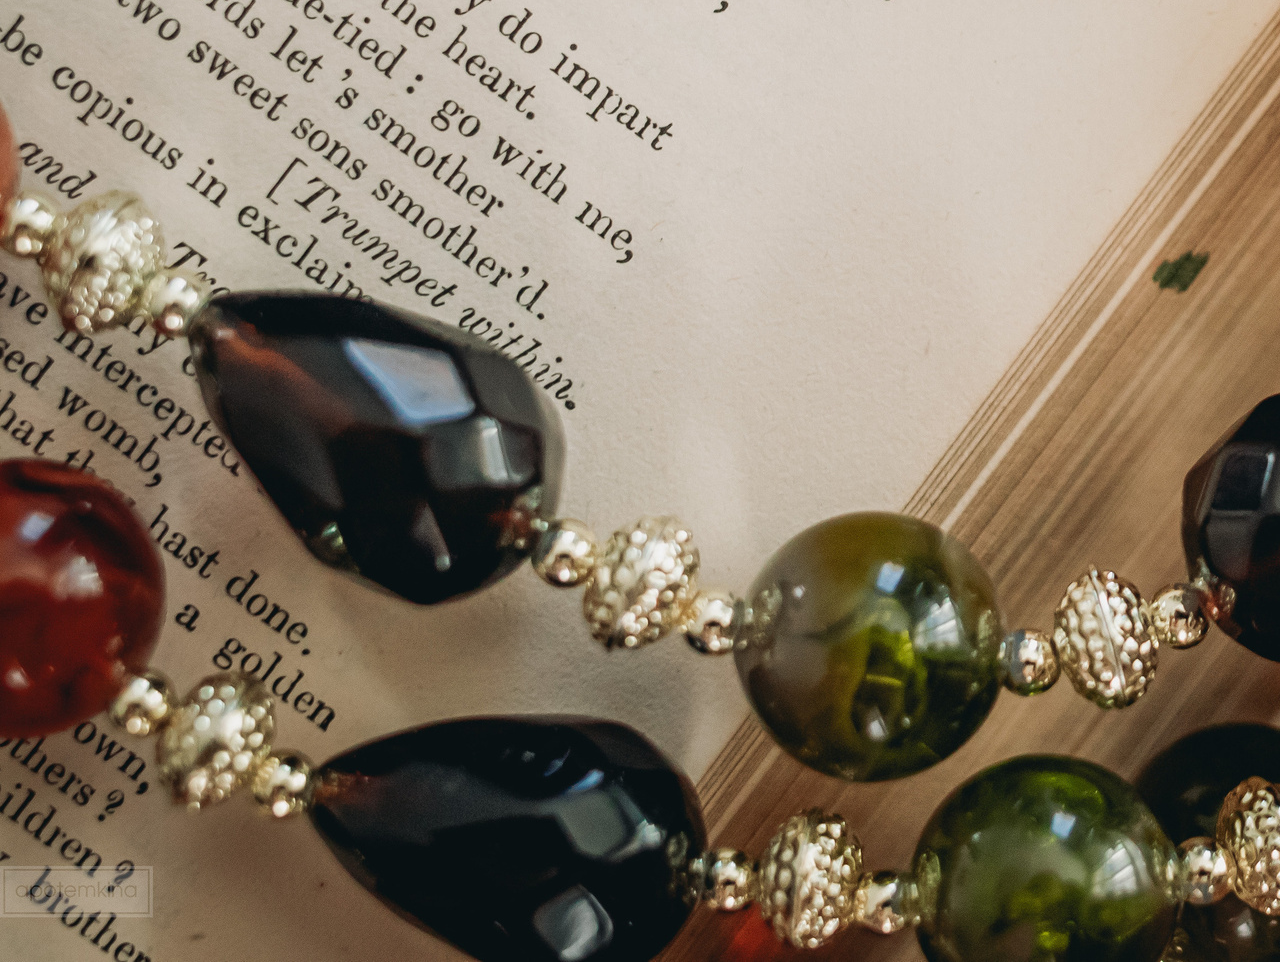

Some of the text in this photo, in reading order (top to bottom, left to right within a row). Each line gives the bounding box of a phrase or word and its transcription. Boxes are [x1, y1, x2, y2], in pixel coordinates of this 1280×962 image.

[0, 15, 43, 66] be
[52, 67, 183, 170] copious
[187, 158, 227, 208] in
[442, 25, 536, 120] heart.
[499, 8, 542, 54] do
[550, 44, 672, 150] impart
[20, 144, 97, 200] and
[187, 41, 288, 121] sweet
[291, 118, 367, 180] sons
[371, 179, 549, 320] smother'd.
[363, 109, 504, 217] smother
[431, 100, 480, 137] go
[493, 136, 567, 204] with
[575, 201, 633, 263] me,
[266, 157, 577, 412] [Trumpet within.
[58, 386, 162, 488] womb,
[150, 504, 220, 579] hast
[225, 570, 310, 656] done.
[175, 604, 338, 732] a golden
